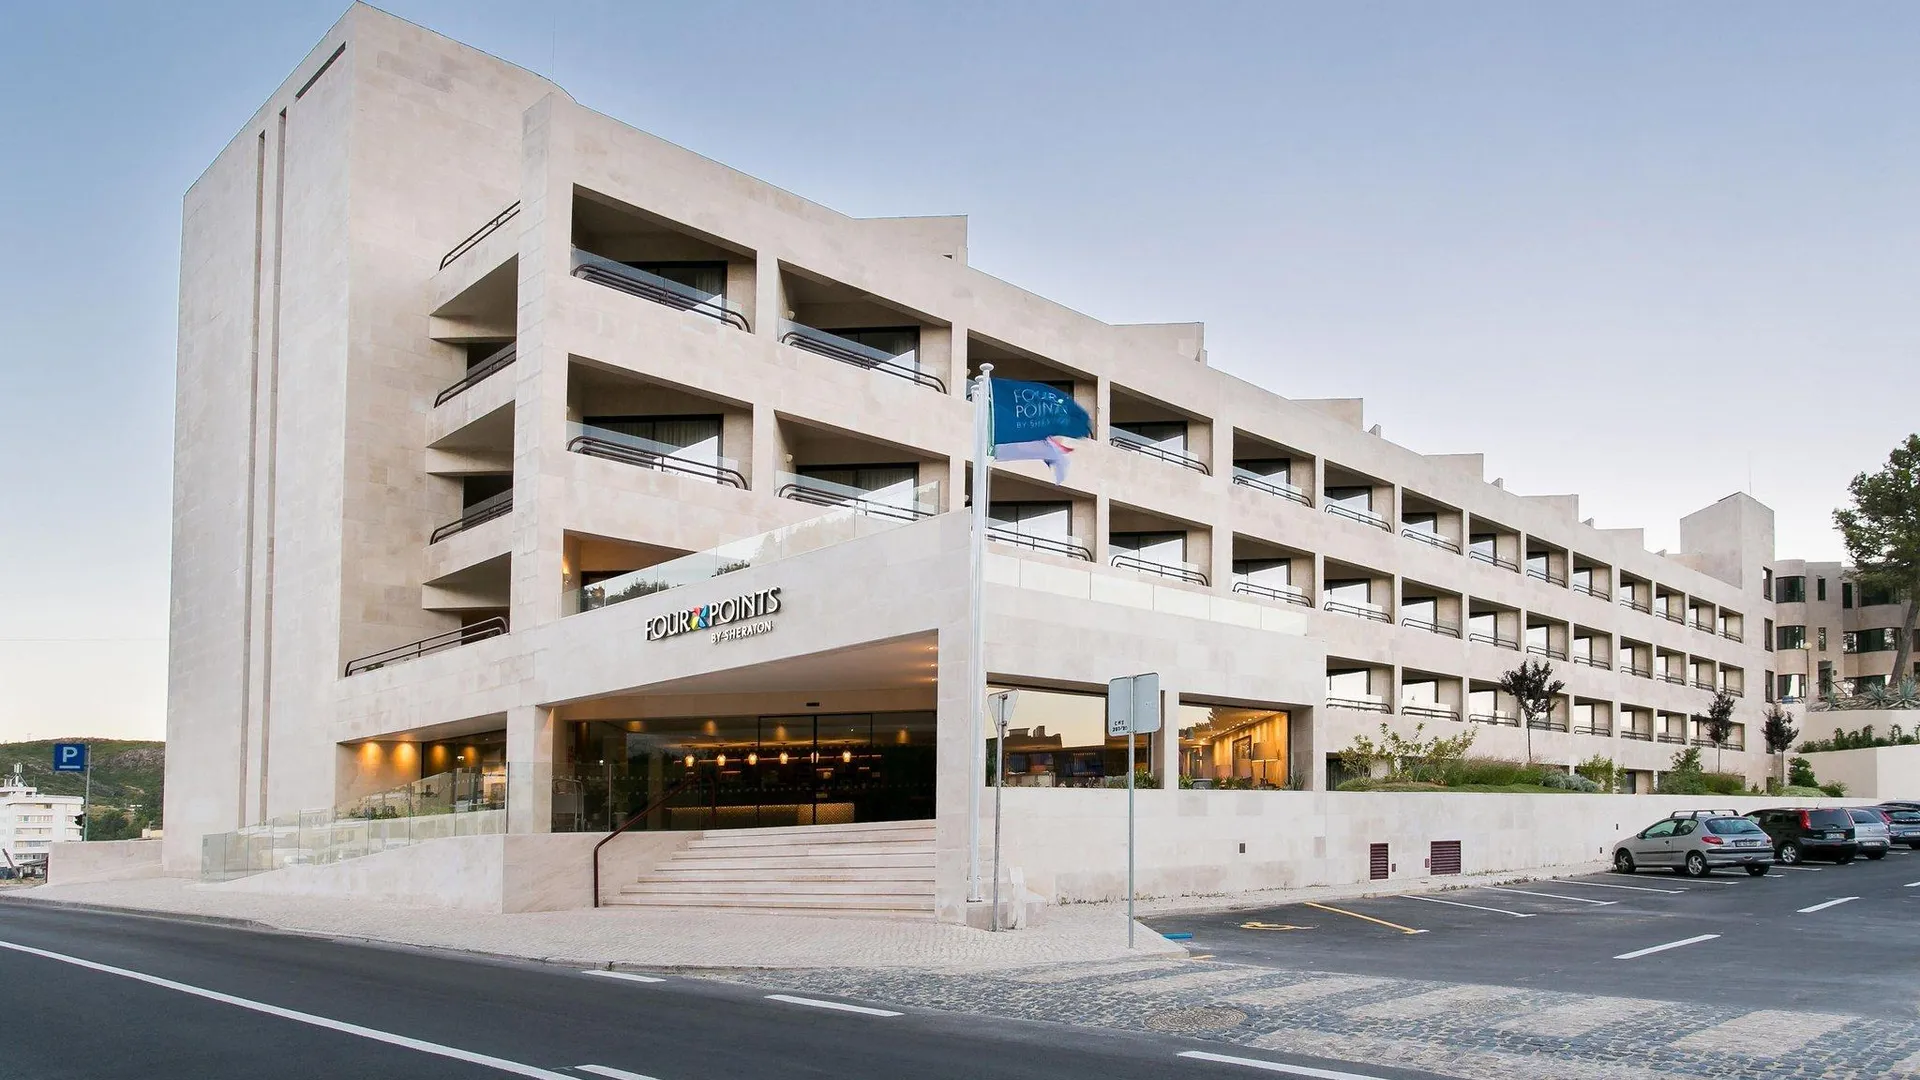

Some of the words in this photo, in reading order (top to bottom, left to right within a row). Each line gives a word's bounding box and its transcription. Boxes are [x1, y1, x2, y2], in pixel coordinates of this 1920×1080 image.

[645, 609, 691, 641] FOUR
[708, 586, 782, 627] POINTS
[710, 631, 723, 644] BY
[724, 620, 773, 641] SHERATON
[62, 746, 78, 763] P
